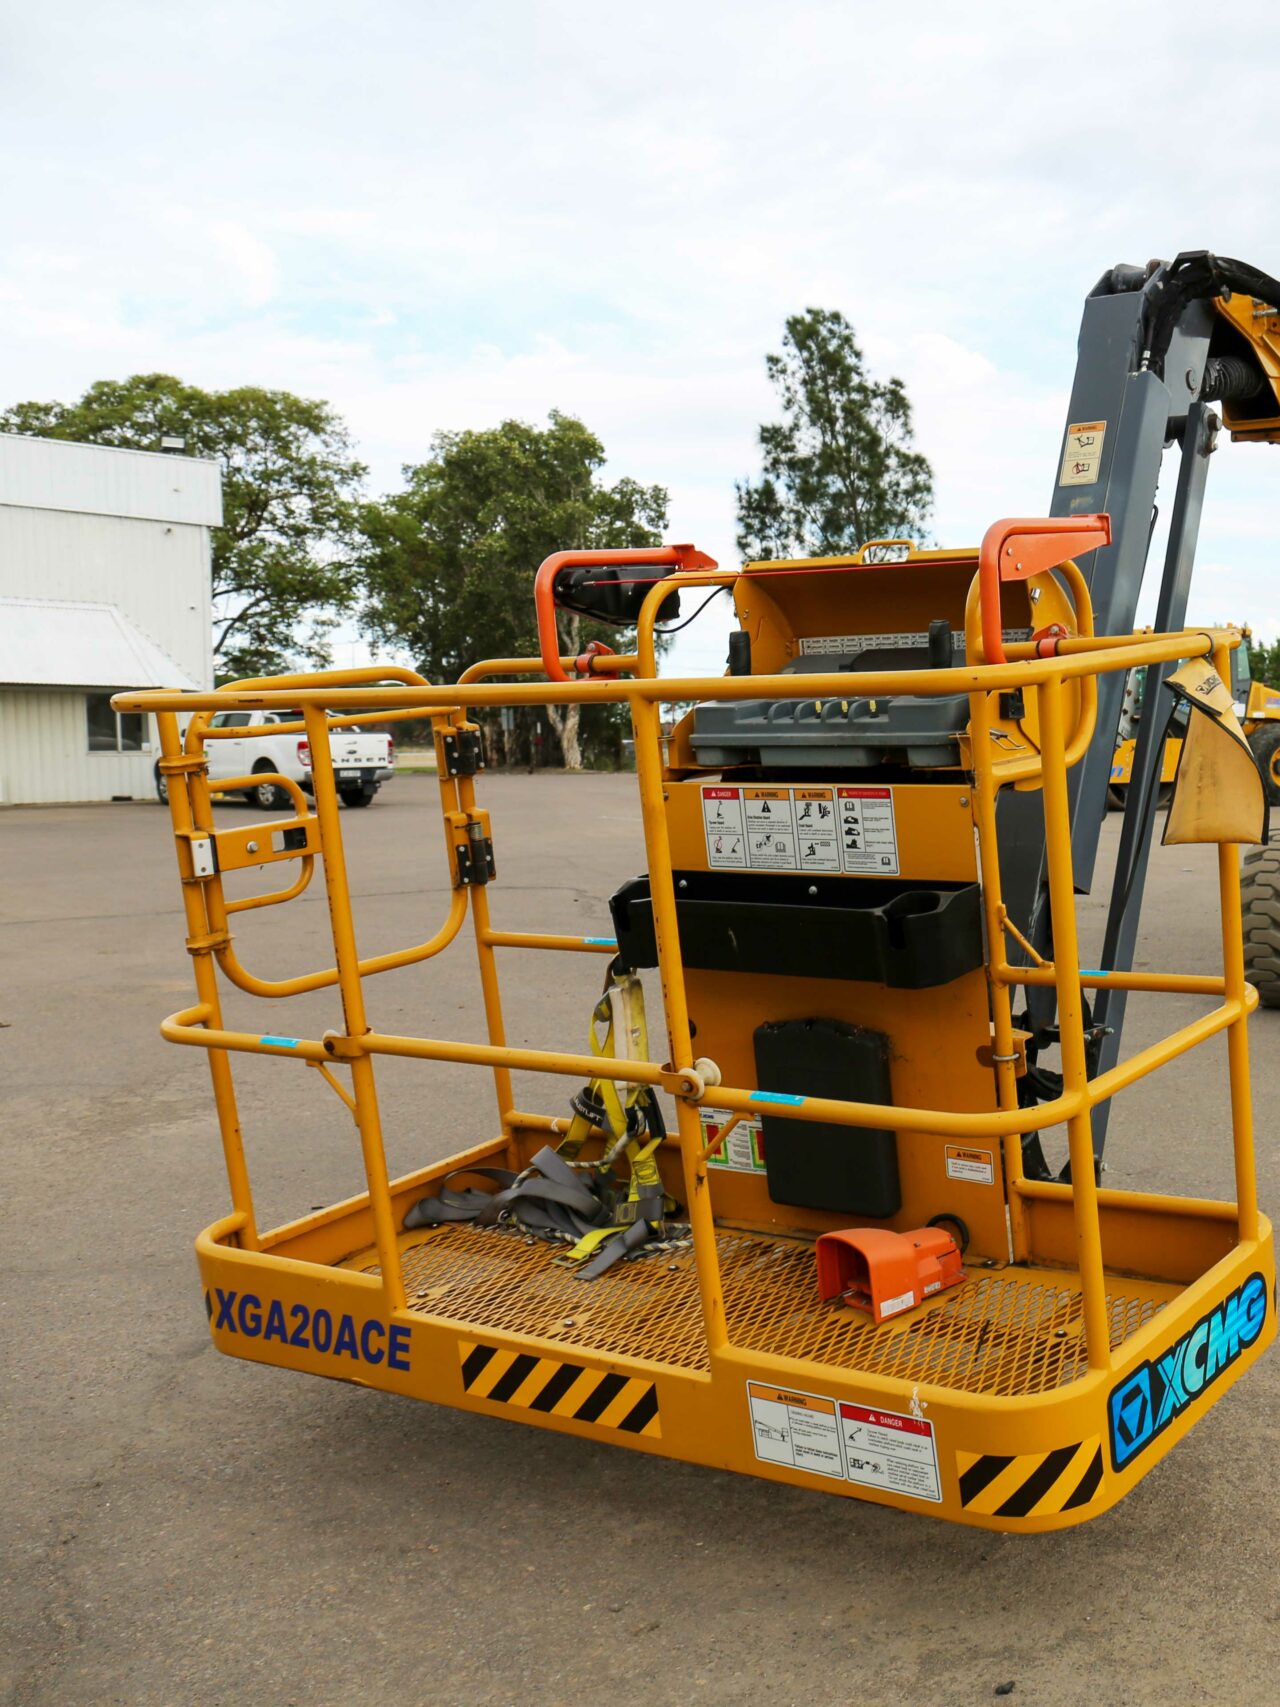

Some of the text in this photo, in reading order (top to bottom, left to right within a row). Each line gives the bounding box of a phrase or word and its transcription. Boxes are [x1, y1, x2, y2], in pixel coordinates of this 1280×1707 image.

[214, 1287, 413, 1372] XGA20ACE
[1154, 1277, 1265, 1430] XCMG
[783, 1395, 808, 1406] WARNING
[880, 1416, 904, 1428] DANGER
